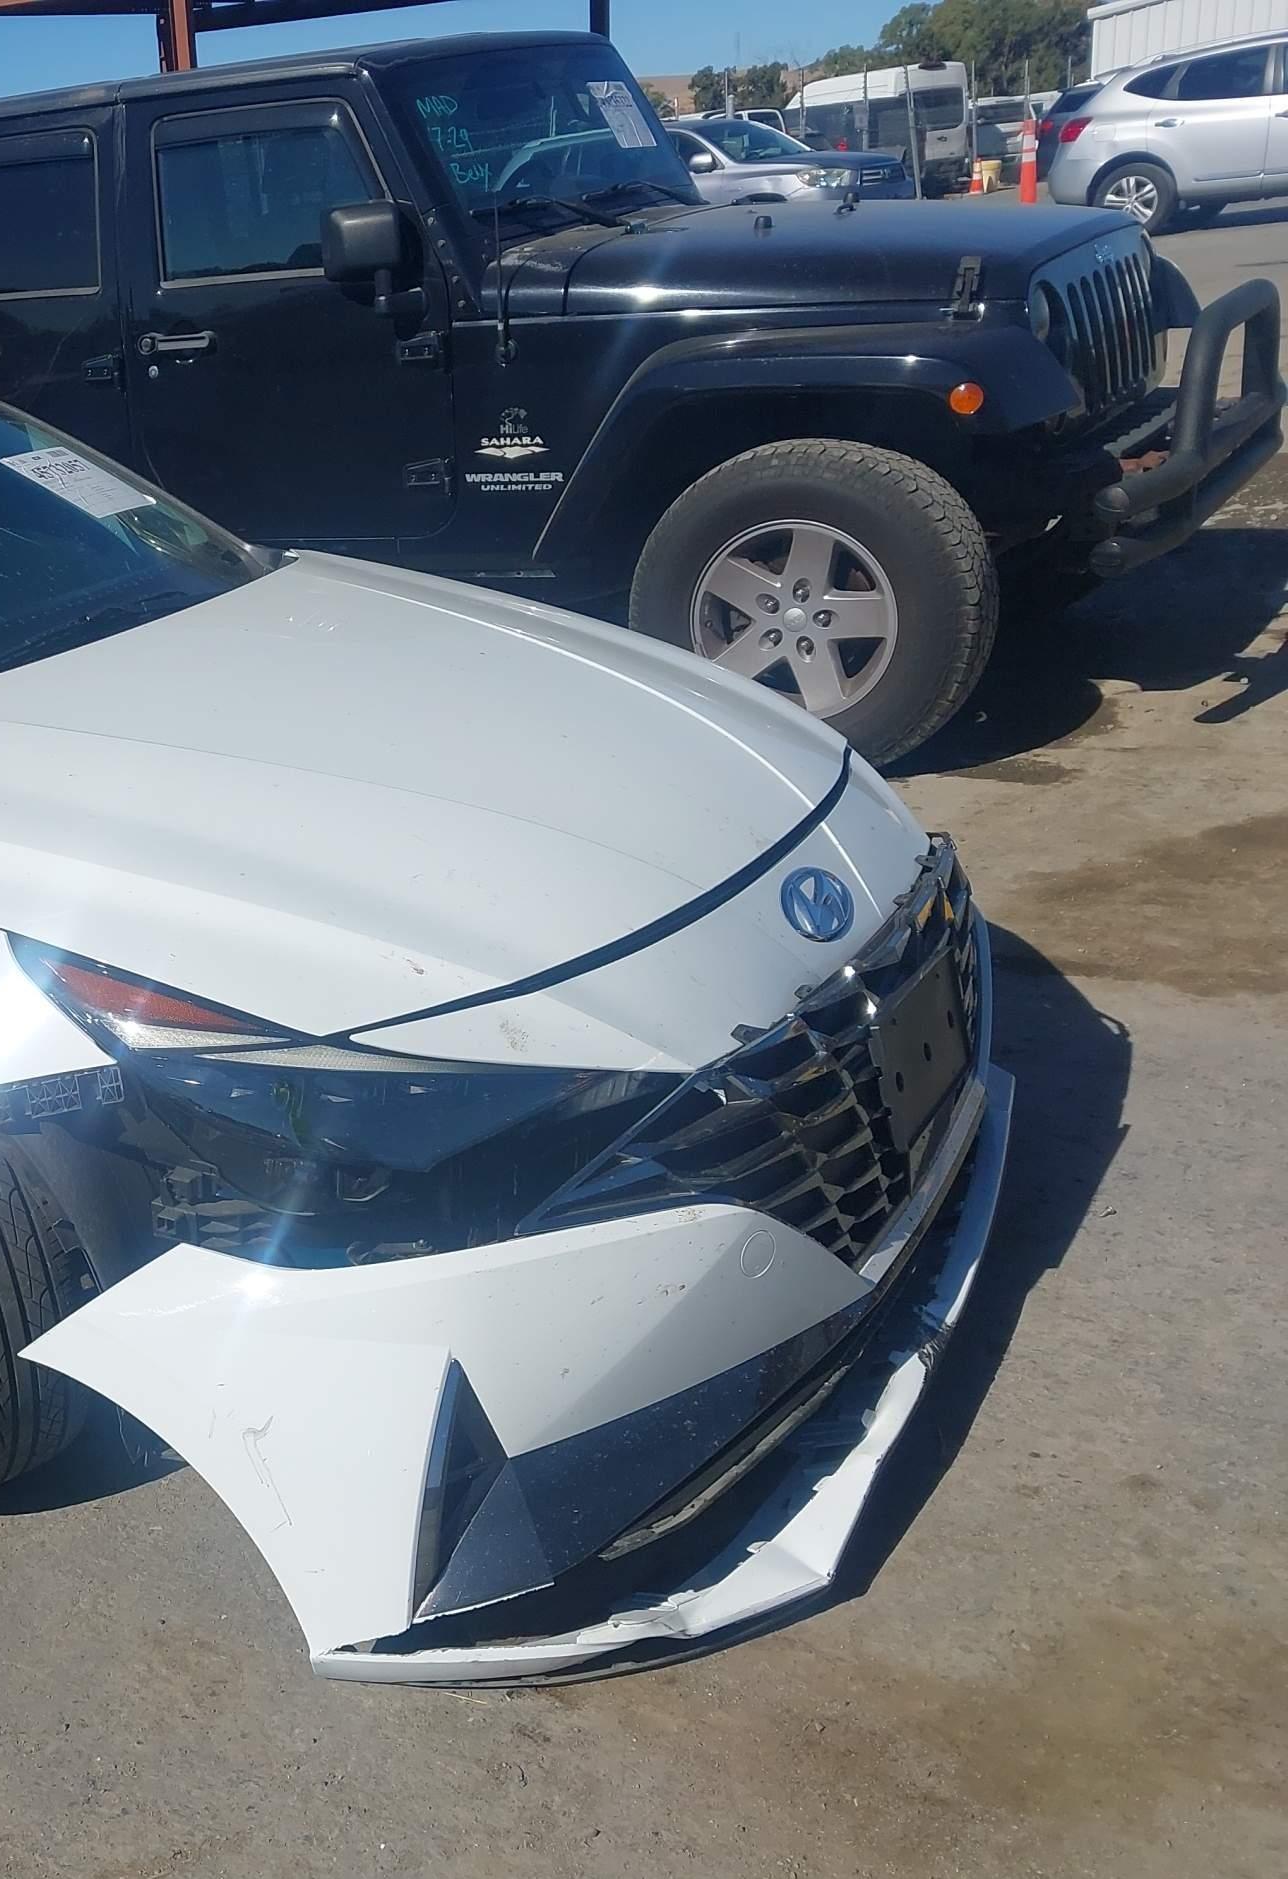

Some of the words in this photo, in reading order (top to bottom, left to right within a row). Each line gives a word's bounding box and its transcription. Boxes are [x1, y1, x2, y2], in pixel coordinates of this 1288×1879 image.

[480, 436, 544, 446] SAHARA
[464, 472, 564, 483] WRANGLER
[480, 483, 553, 492] UNLIMITED
